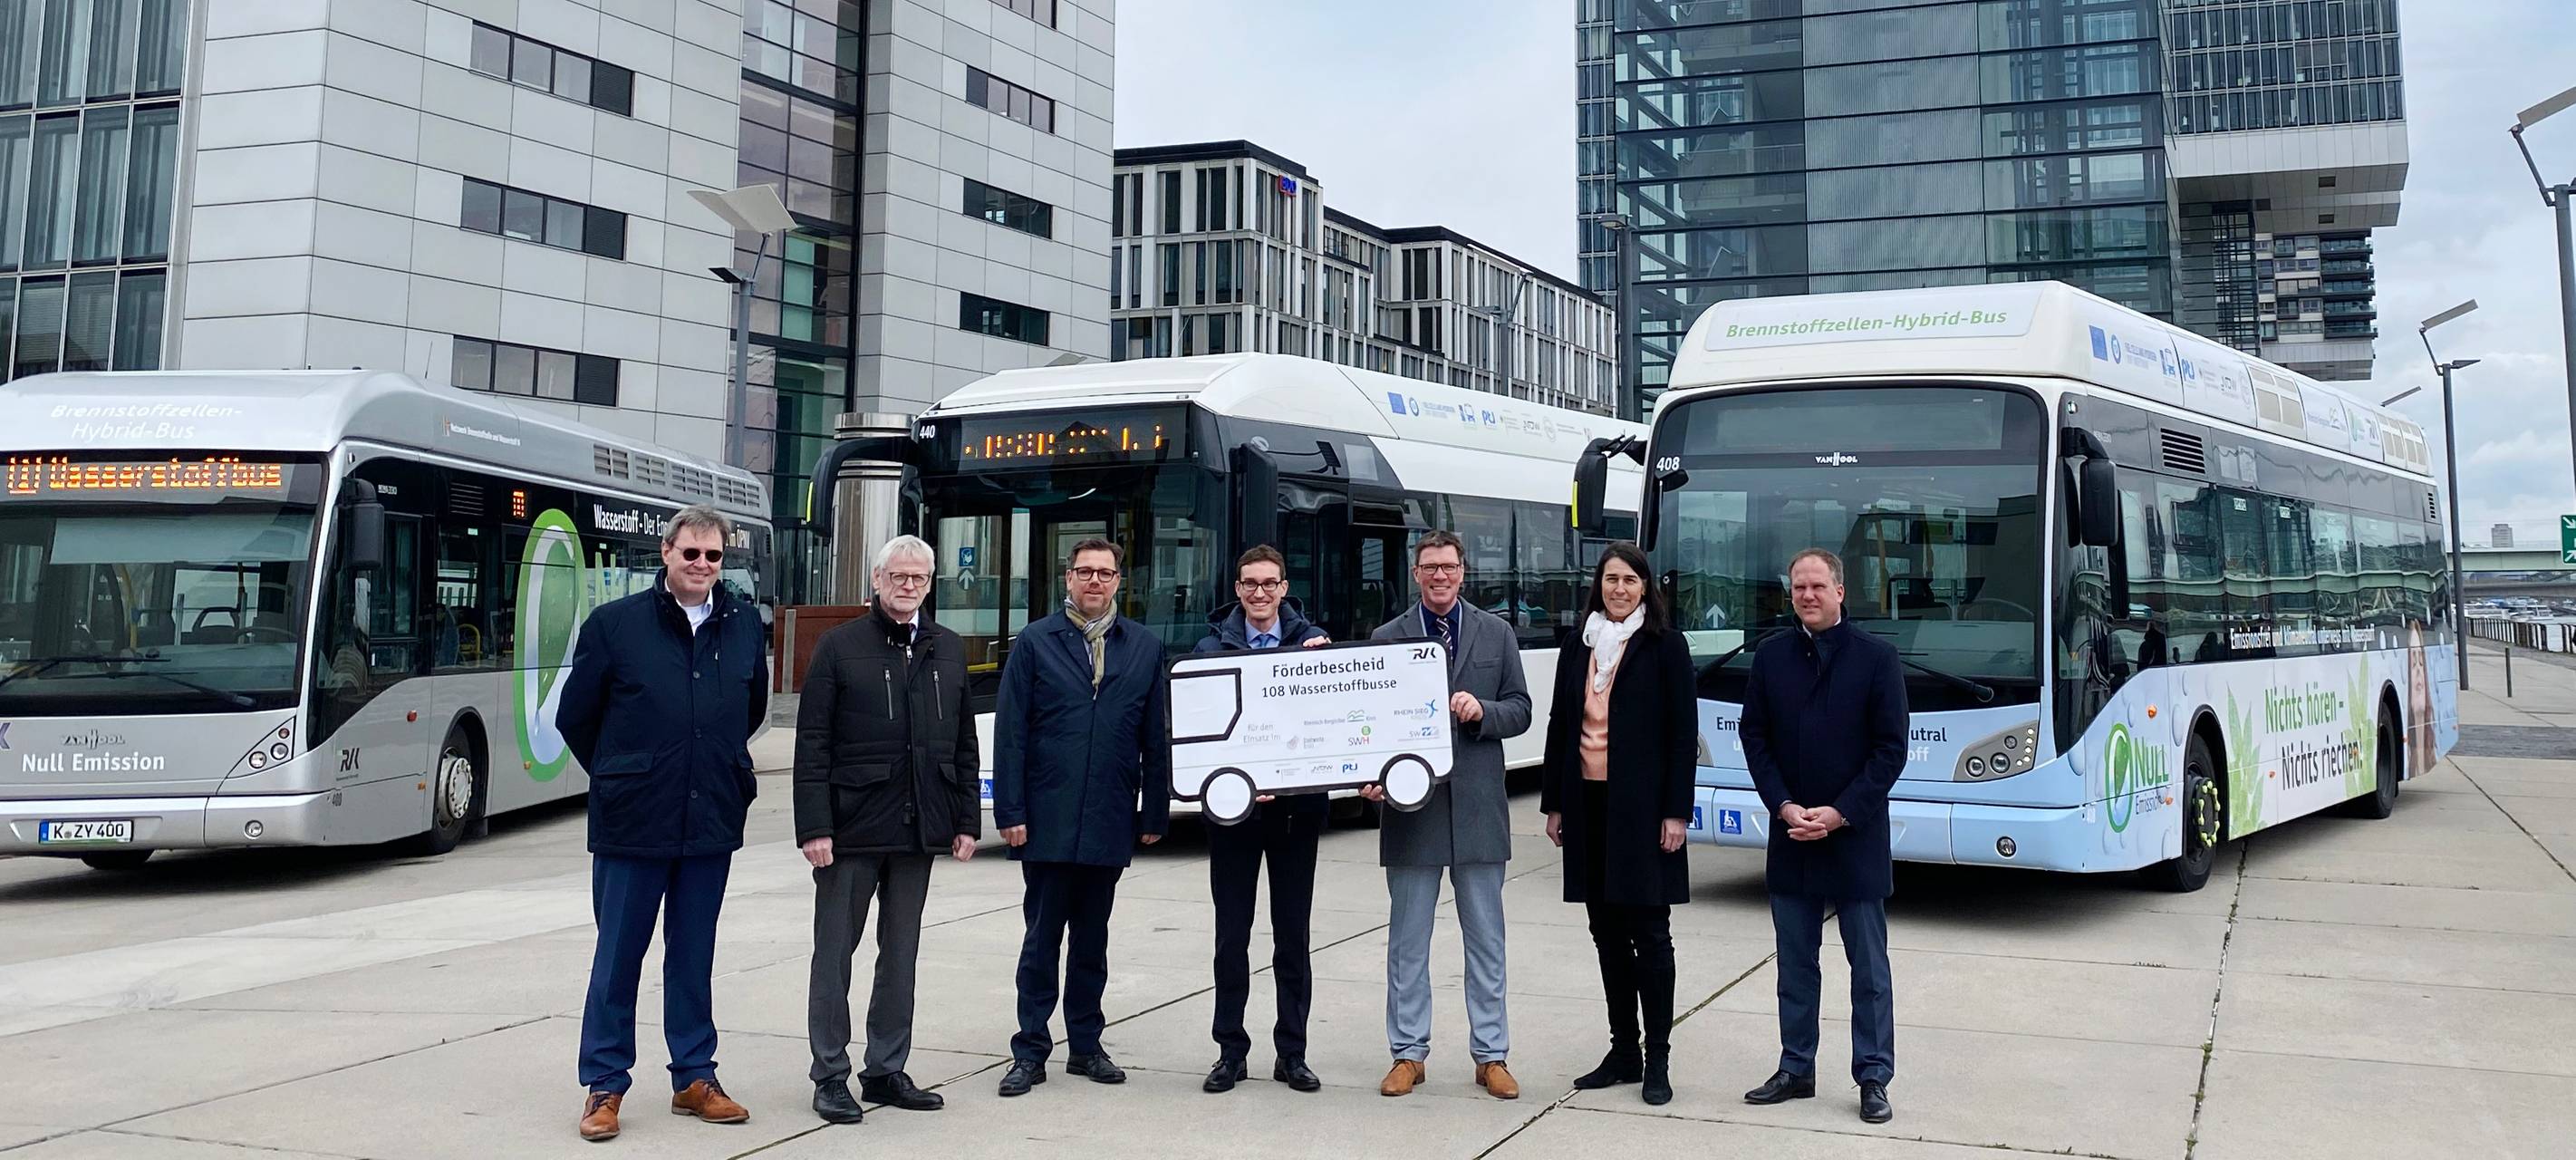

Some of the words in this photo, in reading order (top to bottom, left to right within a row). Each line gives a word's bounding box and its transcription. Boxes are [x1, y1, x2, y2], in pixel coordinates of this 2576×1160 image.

[1725, 309, 2008, 339] Brennstoffzellen-Hybrid-Bus
[51, 403, 244, 420] Brennstoffzellen-
[72, 421, 196, 442] Hybrid-Bus
[919, 425, 936, 440] 440
[1656, 456, 1680, 472] 408
[593, 503, 639, 535] Wasserstoff
[643, 512, 656, 536] Der
[1272, 657, 1384, 678] Förderbescheid
[1262, 685, 1286, 699] 108
[1288, 679, 1397, 696] Wasserstoffbusse
[2265, 685, 2303, 734] Nichts
[2306, 682, 2337, 726] hören
[1260, 723, 1274, 731] den
[1910, 727, 1947, 742] utral
[1243, 734, 1269, 743] Einsatz
[22, 752, 64, 772] Null
[72, 751, 165, 771] Emission
[1907, 746, 1929, 762] off
[2282, 738, 2319, 791] Nichts
[2321, 728, 2364, 776] riechen!
[53, 824, 63, 839] K
[73, 824, 94, 838] ZY
[96, 823, 124, 838] 400
